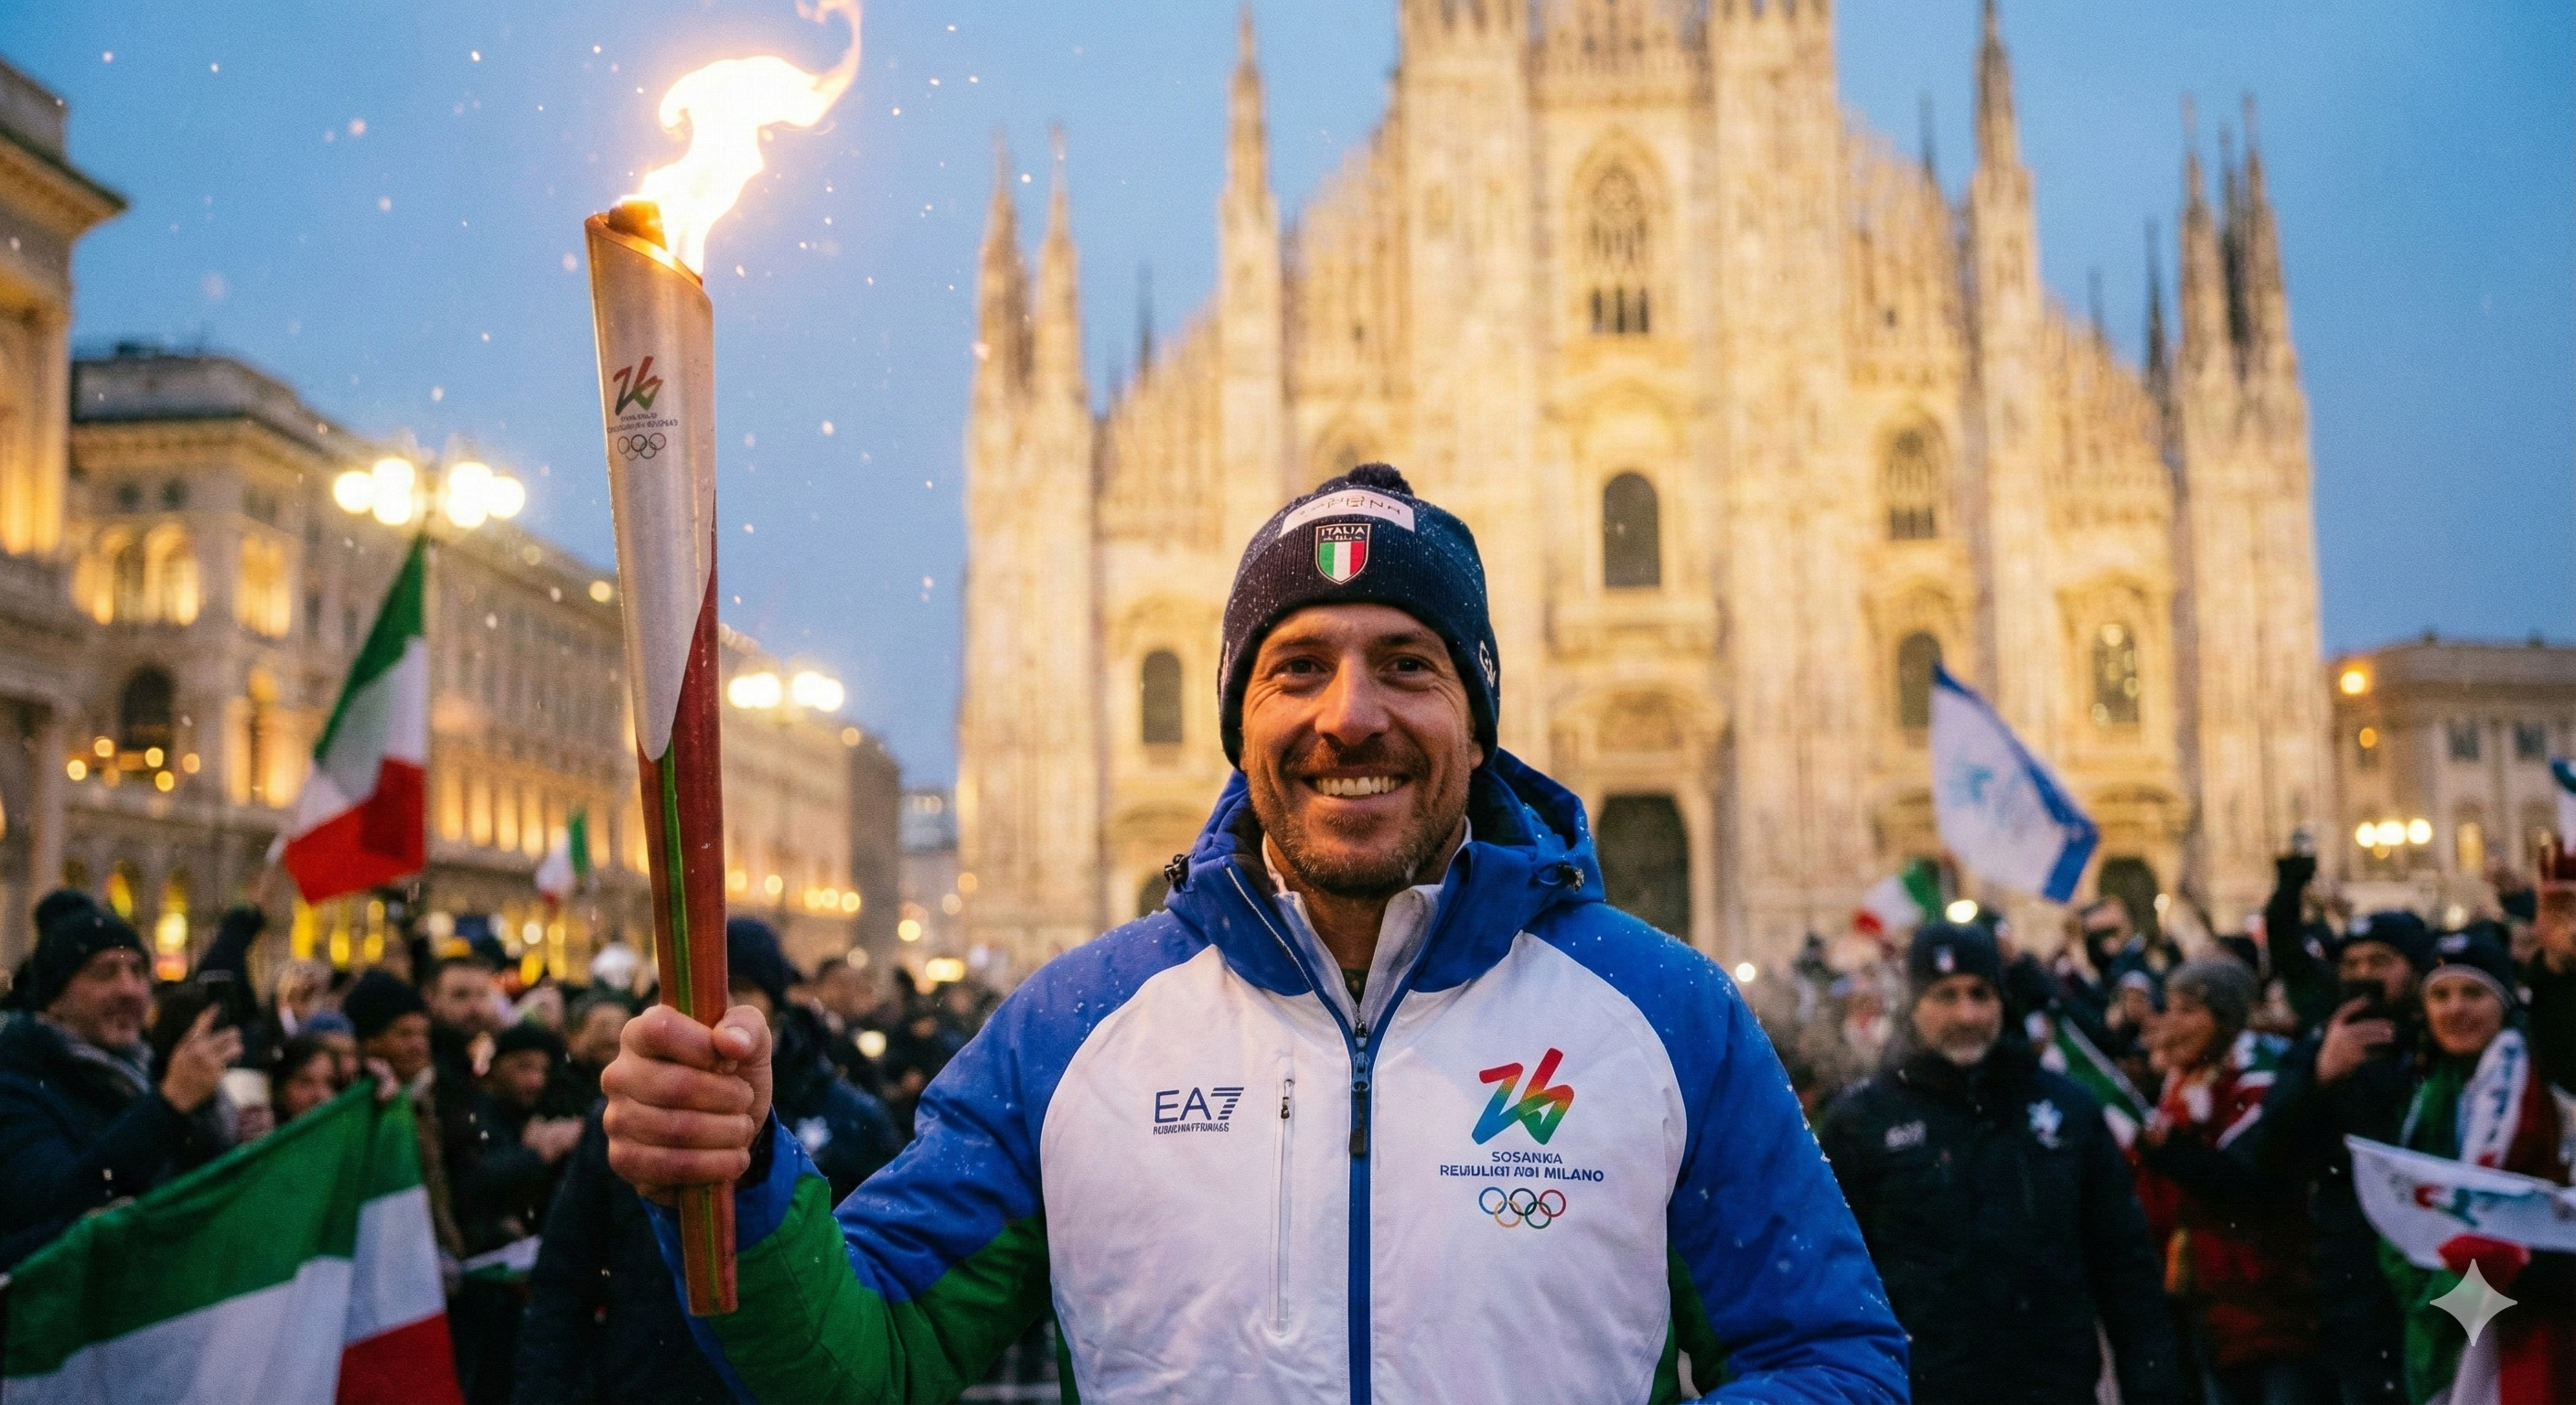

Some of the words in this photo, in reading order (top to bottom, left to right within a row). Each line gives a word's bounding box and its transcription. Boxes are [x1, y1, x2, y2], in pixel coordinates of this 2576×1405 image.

[1321, 526, 1366, 537] ITALIA
[1154, 1087, 1245, 1123] EA7
[1543, 1166, 1605, 1183] MILANO
